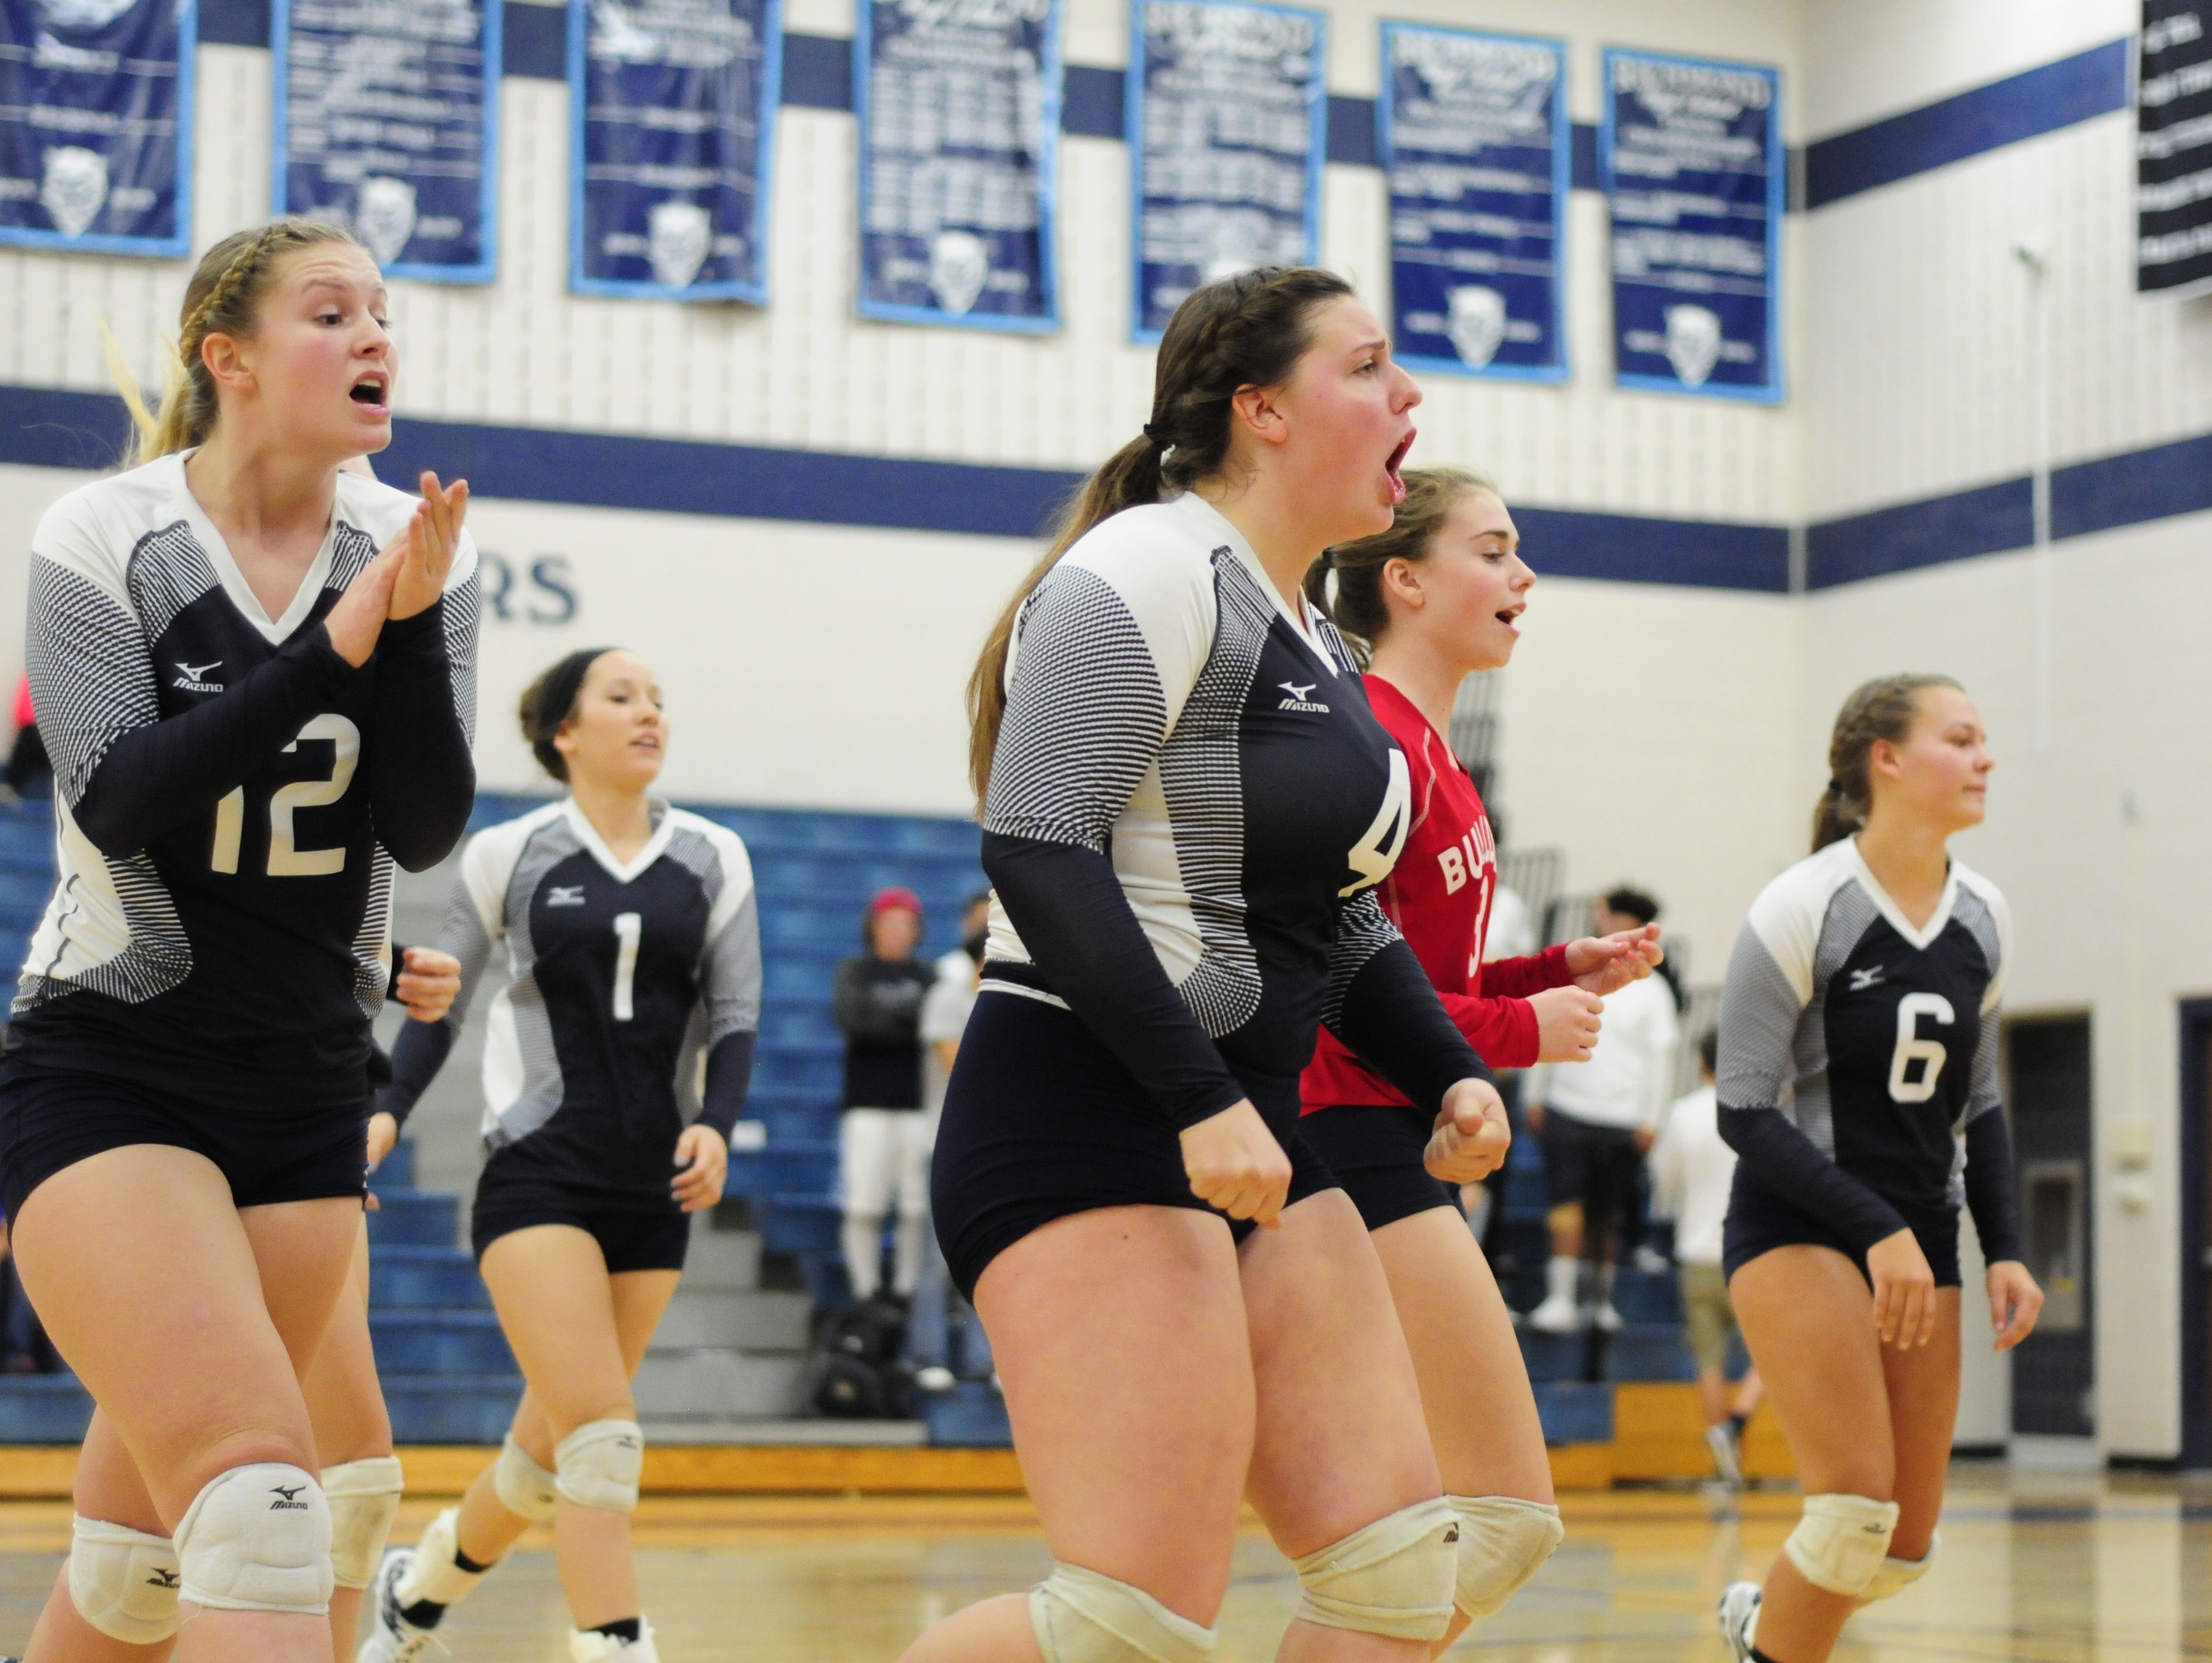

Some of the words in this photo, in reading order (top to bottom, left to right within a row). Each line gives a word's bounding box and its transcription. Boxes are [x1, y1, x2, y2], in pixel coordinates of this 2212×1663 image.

[173, 677, 223, 693] MIZUNO
[1278, 698, 1330, 713] MIZUNO
[211, 713, 360, 876] 12
[614, 912, 642, 1021] 1
[1888, 992, 1955, 1103] 6
